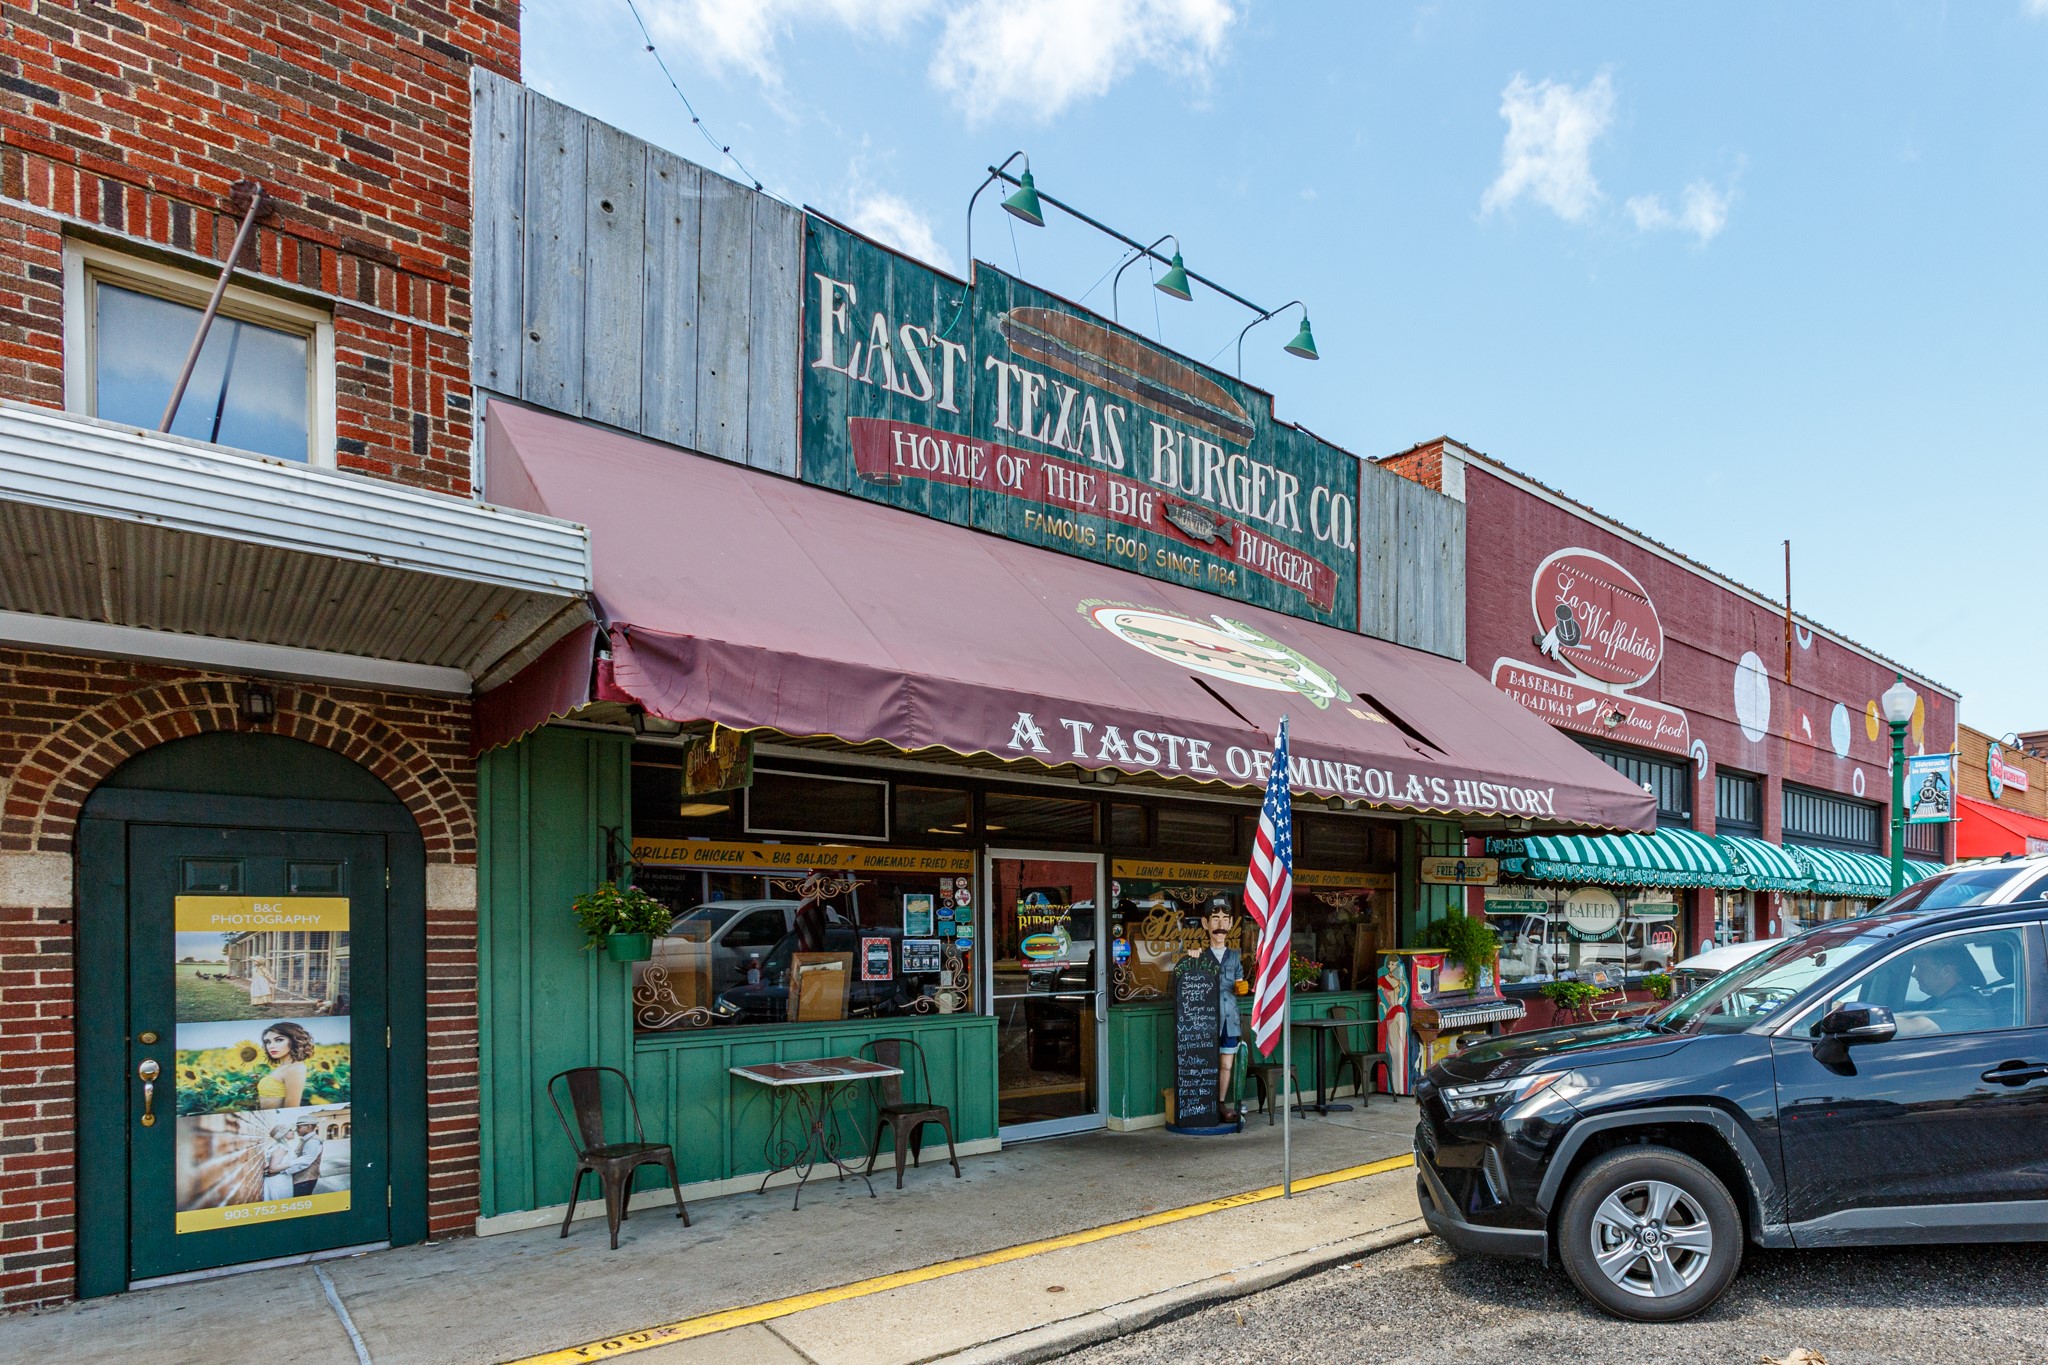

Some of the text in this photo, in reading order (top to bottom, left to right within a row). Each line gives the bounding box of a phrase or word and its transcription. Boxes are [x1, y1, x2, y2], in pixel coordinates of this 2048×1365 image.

[811, 273, 1356, 553] EAST TEXAS BURGER CO.
[891, 430, 987, 482] HOME
[996, 454, 1031, 490] OF
[1040, 462, 1097, 508] THE
[1107, 480, 1153, 525] BIG
[1237, 529, 1313, 591] BURGER
[1025, 510, 1237, 586] FAMOUS FOOD SINCE 1984
[1555, 572, 1580, 608] La
[1508, 670, 1574, 700] BASEBALL
[1505, 688, 1575, 718] BROADWAY
[1653, 714, 1685, 741] food
[1007, 711, 1557, 816] A TASTE OF MINEOLA'S HISTORY
[633, 847, 971, 870] GRILLED CHICKEN BIG SALADS HOMEMADE FRIED PIES
[1135, 866, 1164, 876] LUNCH
[1168, 868, 1174, 877] &
[1179, 868, 1210, 879] DINNER
[1322, 875, 1341, 885] FOOD
[253, 903, 282, 913] B&C
[1569, 902, 1616, 919] BAKERY
[211, 914, 321, 925] PHOTOGRAPHY
[1150, 940, 1180, 952] OLD
[1652, 931, 1673, 951] OPEN
[224, 1200, 313, 1221] 903.752.5459
